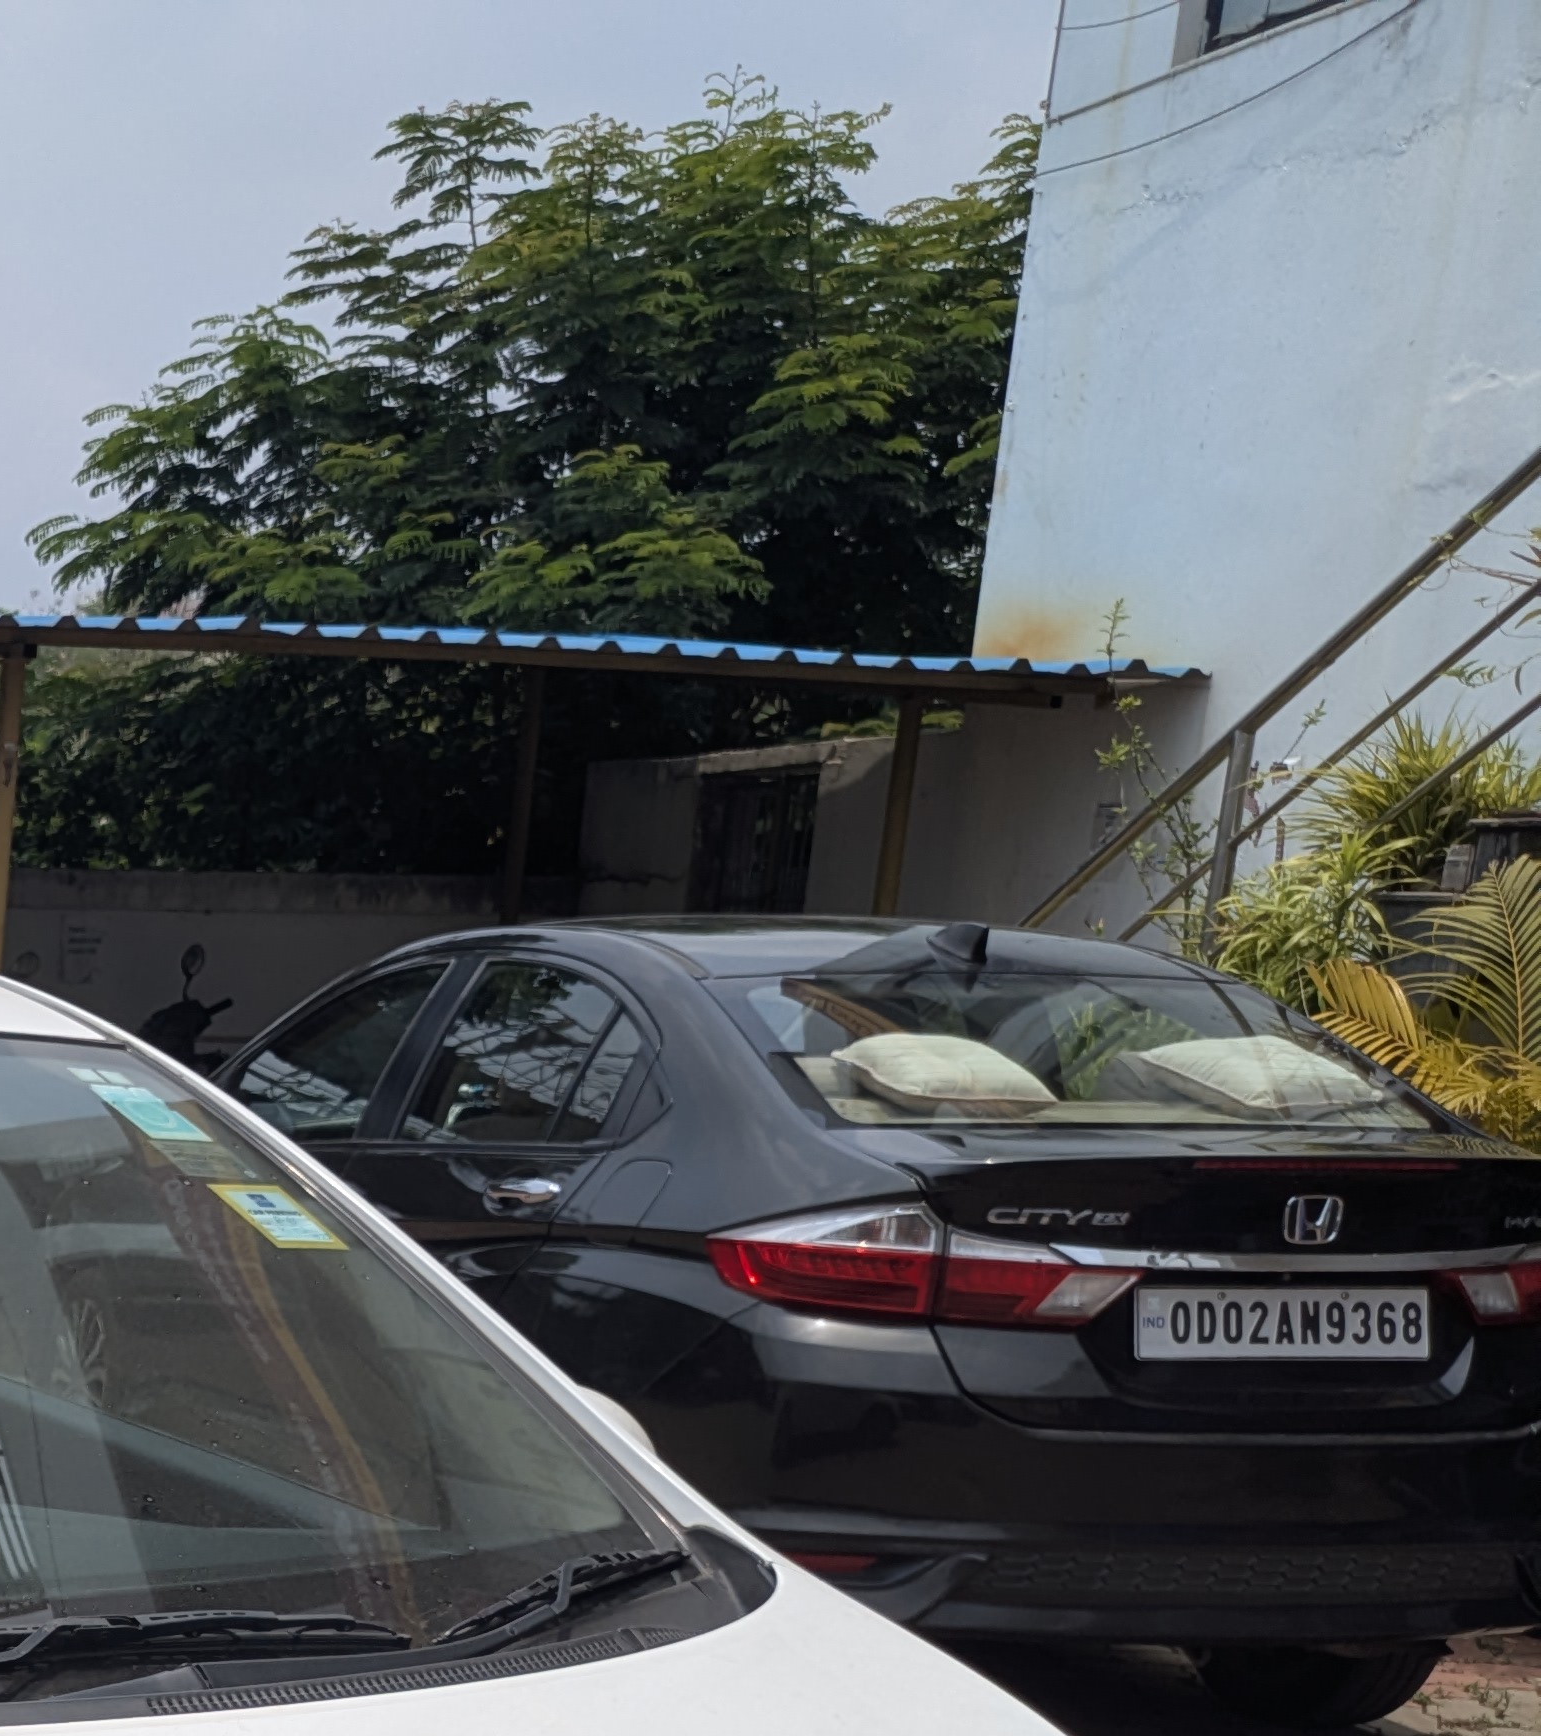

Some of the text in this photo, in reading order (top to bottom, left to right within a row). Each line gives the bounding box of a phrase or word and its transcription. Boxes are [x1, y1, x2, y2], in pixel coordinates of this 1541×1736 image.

[986, 1206, 1094, 1226] CITY
[1142, 1315, 1166, 1330] IND
[1170, 1300, 1422, 1345] OD02AN9368
